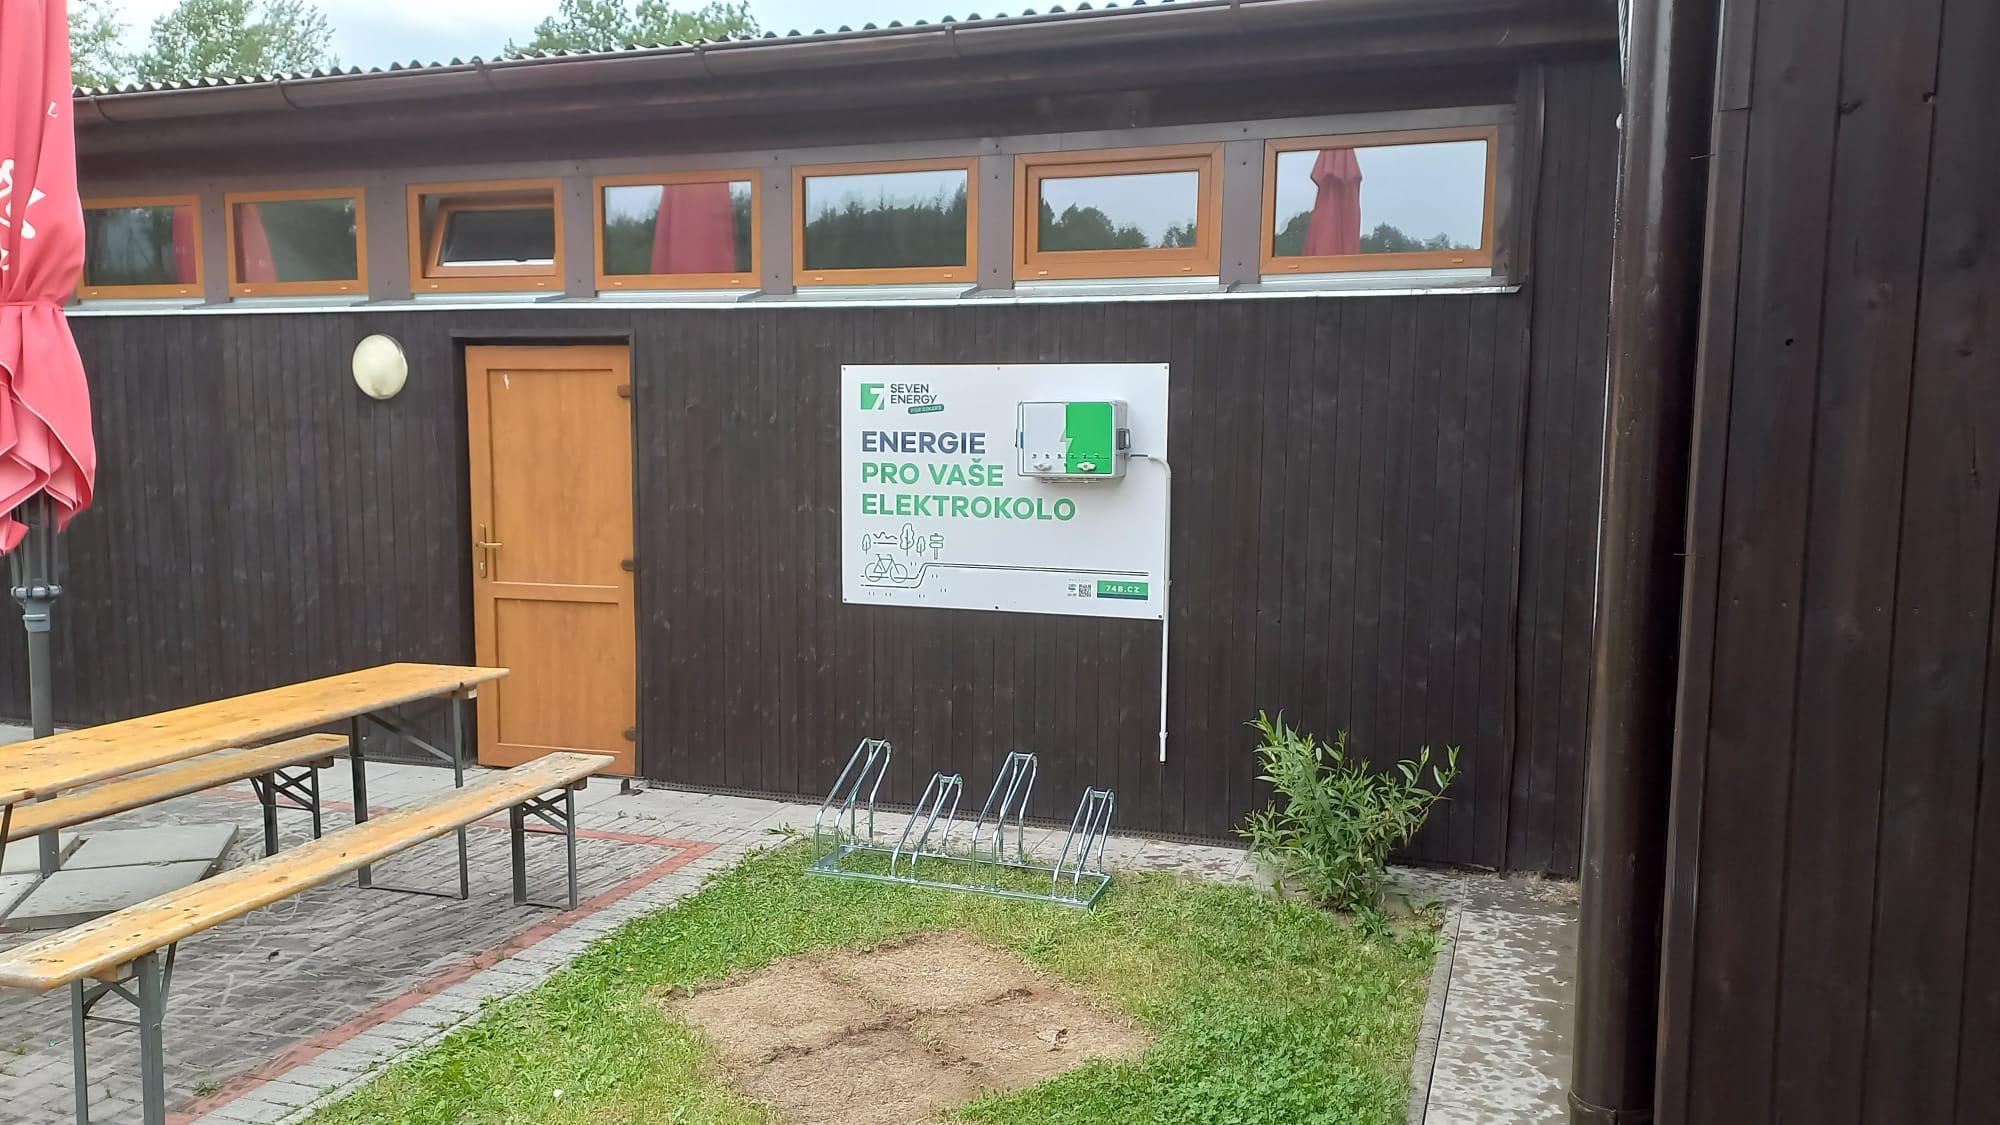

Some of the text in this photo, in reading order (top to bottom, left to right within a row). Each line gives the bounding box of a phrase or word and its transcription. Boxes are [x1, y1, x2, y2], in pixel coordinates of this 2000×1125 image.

[890, 394, 938, 405] ENERGY
[862, 430, 986, 454] ENERGIE
[862, 457, 1004, 487] PRO VAŠE
[862, 493, 1077, 521] ELEKTROKOLO
